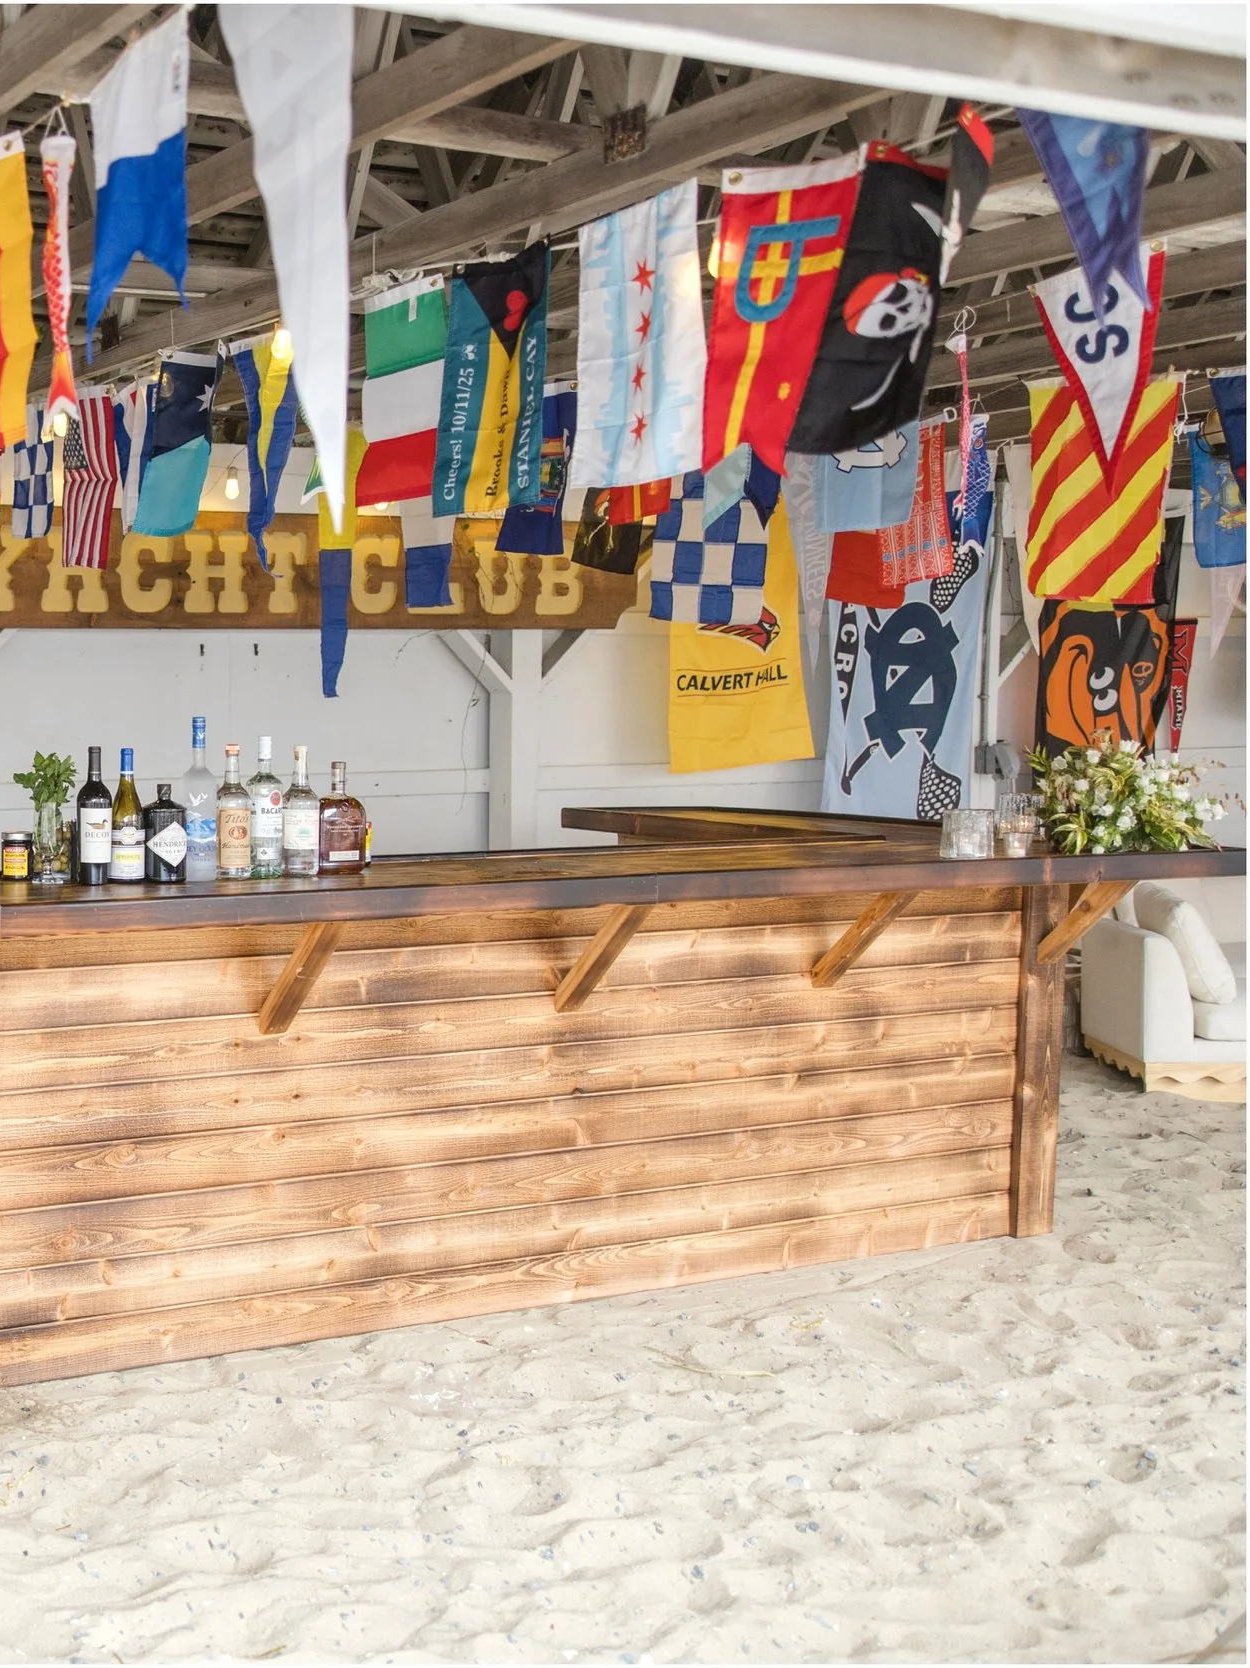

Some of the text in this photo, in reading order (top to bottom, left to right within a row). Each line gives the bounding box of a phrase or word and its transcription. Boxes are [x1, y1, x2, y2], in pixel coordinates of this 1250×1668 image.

[525, 335, 538, 382] CAY
[443, 367, 475, 501] Cheers! 10/11/25
[517, 385, 536, 489] STANIEL
[676, 664, 788, 691] CALVERT HALL
[1173, 685, 1183, 728] MIAMI
